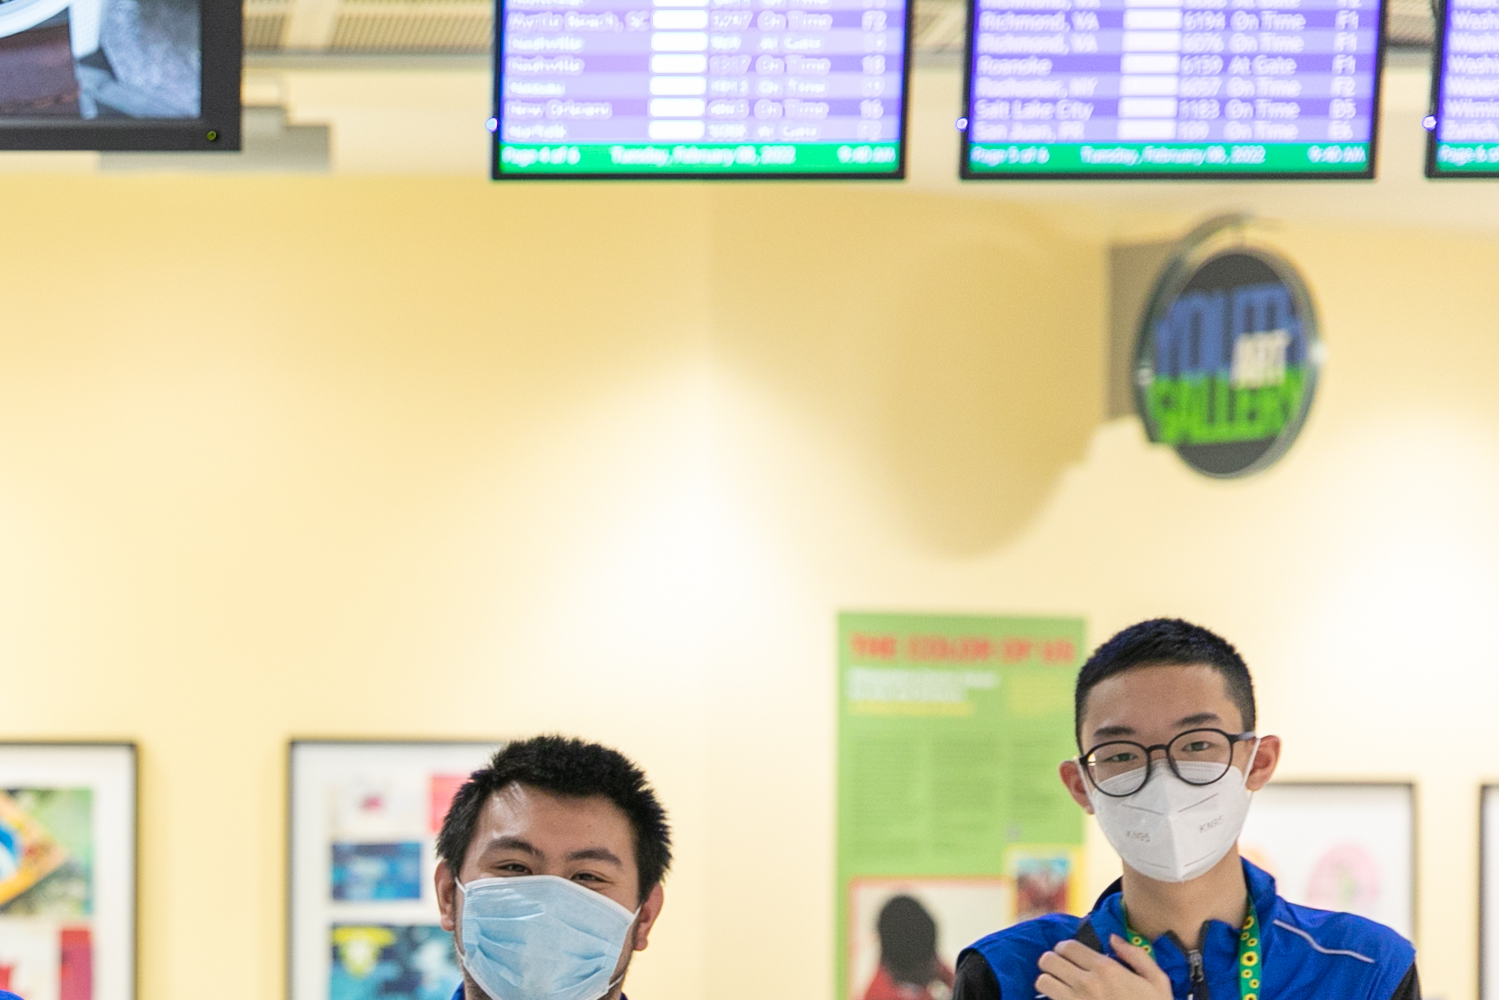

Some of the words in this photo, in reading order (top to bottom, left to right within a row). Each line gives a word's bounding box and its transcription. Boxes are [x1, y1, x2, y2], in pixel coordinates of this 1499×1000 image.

[978, 11, 1070, 33] Richmond,
[1071, 11, 1099, 31] VA
[1230, 10, 1259, 31] On
[1260, 10, 1306, 31] Time
[1335, 10, 1359, 31] F1
[1070, 32, 1098, 53] VA
[1229, 32, 1257, 53] On
[1258, 32, 1305, 53] Time
[1333, 32, 1357, 53] F1
[976, 55, 1053, 76] Roanoke
[1226, 55, 1251, 76] At
[1252, 55, 1297, 76] Gate
[1332, 55, 1356, 76] F1
[1226, 77, 1255, 97] On
[1256, 77, 1301, 97] Time
[974, 99, 1010, 121] Salt
[1011, 99, 1054, 121] Lake
[1055, 99, 1094, 122] City
[1225, 99, 1253, 120] On
[1254, 99, 1300, 120] Time
[1223, 121, 1252, 141] On
[1253, 121, 1299, 141] Time
[610, 146, 672, 167] Tuesday,
[673, 146, 736, 167] February
[970, 146, 1008, 167] Page
[1020, 146, 1036, 164] of
[1080, 146, 1142, 166] Tuesday,
[1143, 146, 1206, 167] February
[1230, 146, 1266, 164] 2022
[1343, 146, 1367, 163] AM
[1439, 144, 1474, 166] Page
